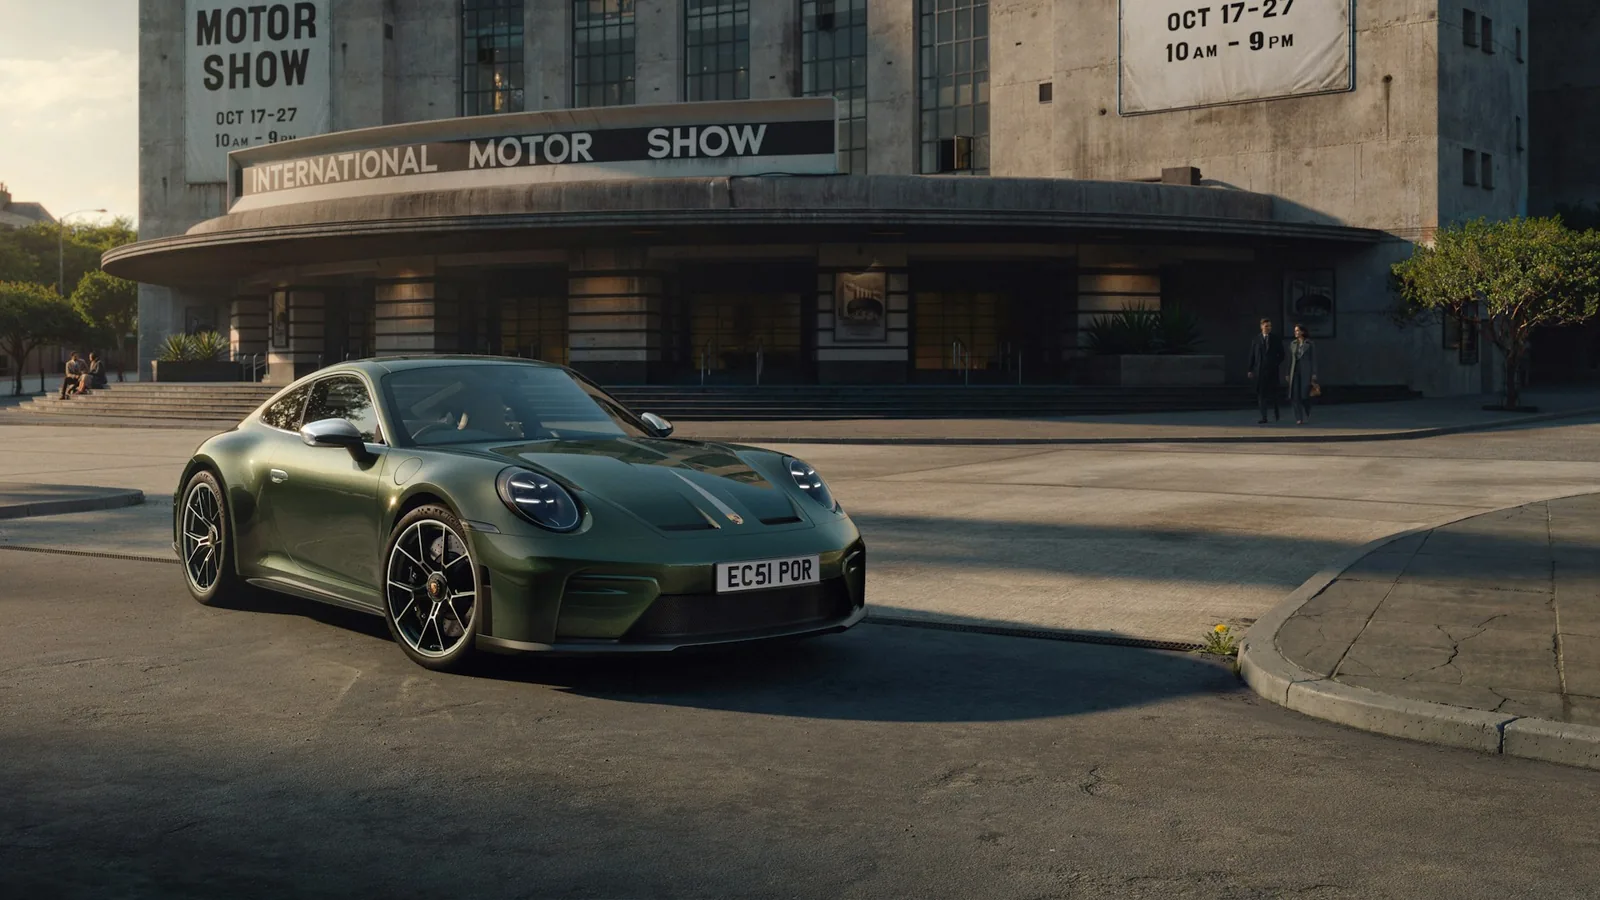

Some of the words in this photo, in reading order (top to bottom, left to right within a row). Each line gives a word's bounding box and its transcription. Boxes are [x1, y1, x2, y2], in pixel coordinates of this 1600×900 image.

[197, 2, 316, 46] MOTOR
[1167, 7, 1211, 31] OCT
[203, 48, 310, 91] SHOW
[216, 110, 244, 125] OCT
[250, 107, 297, 124] 17-27
[252, 145, 437, 193] INTERNATIONAL
[468, 132, 594, 169] MOTOR
[647, 124, 767, 159] SHOW
[779, 559, 812, 583] POR
